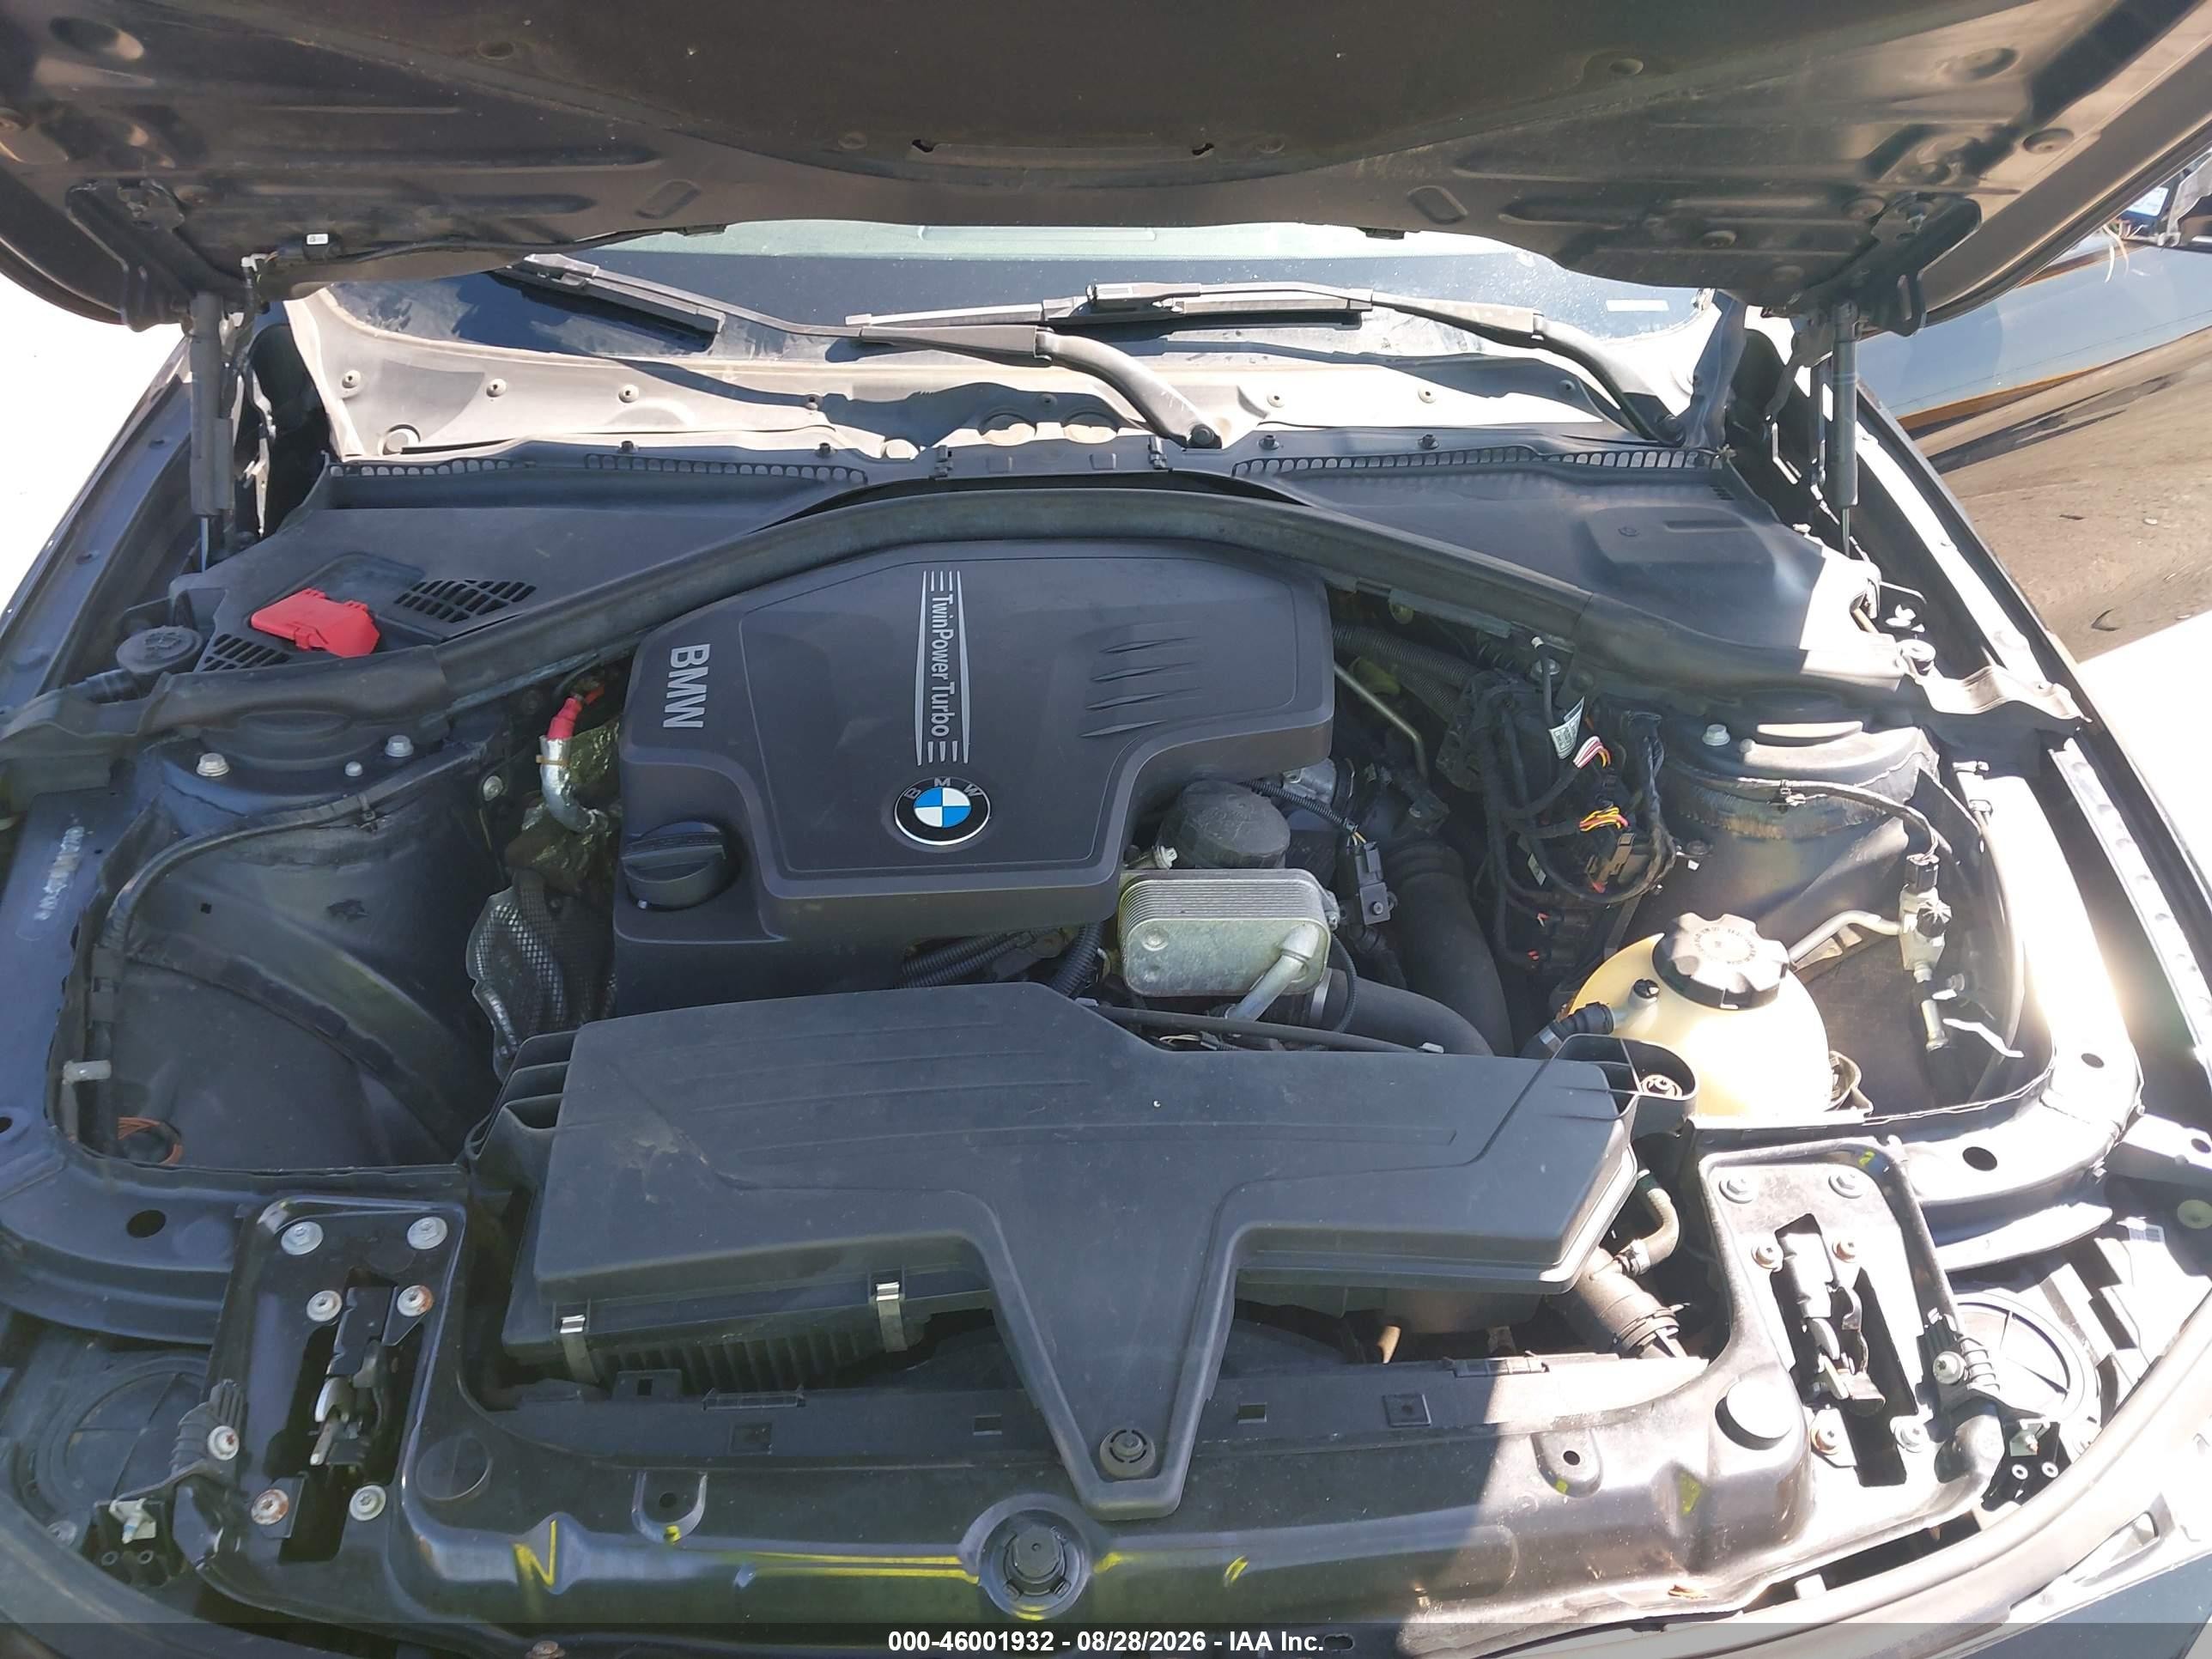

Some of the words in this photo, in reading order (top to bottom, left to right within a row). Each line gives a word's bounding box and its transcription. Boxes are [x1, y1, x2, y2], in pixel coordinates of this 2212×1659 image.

[931, 593, 955, 680] TwinPower
[663, 643, 710, 728] BMW
[931, 682, 956, 737] Turbo
[903, 776, 985, 799] BMW
